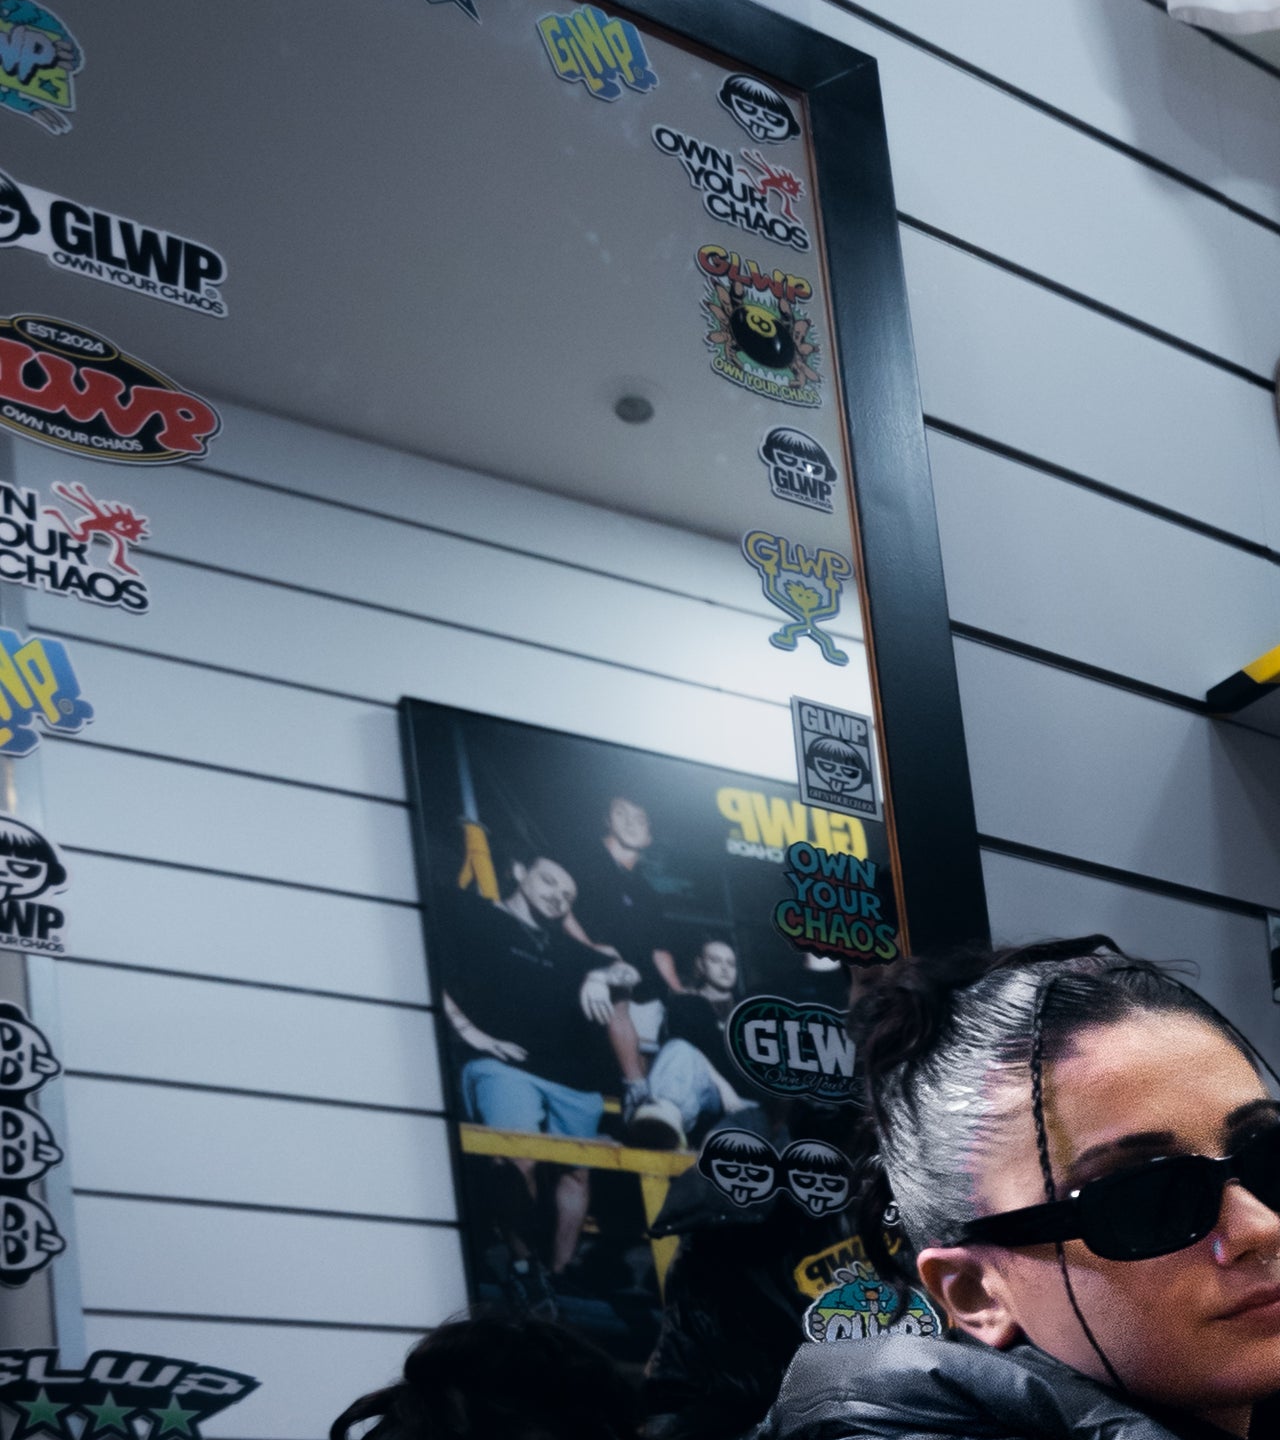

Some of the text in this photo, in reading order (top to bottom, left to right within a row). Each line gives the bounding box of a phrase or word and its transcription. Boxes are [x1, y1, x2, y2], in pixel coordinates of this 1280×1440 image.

[655, 128, 734, 176] OWN
[688, 167, 768, 212] YOUR
[707, 195, 809, 250] CHAOS
[50, 200, 223, 294] GLWP
[53, 251, 224, 315] OWN YOUR CHAOS
[698, 246, 812, 302] GLWP
[26, 322, 105, 355] EST.2024
[714, 358, 819, 405] OWN YOUR CHAOS
[46, 419, 89, 446] YOUR
[91, 434, 143, 453] CHAOS
[774, 467, 832, 501] GLWP
[746, 532, 851, 580] GLWP
[802, 705, 867, 745] GLWP
[787, 841, 878, 889] OWN
[785, 872, 884, 921] YOUR
[775, 900, 898, 960] CHAOS
